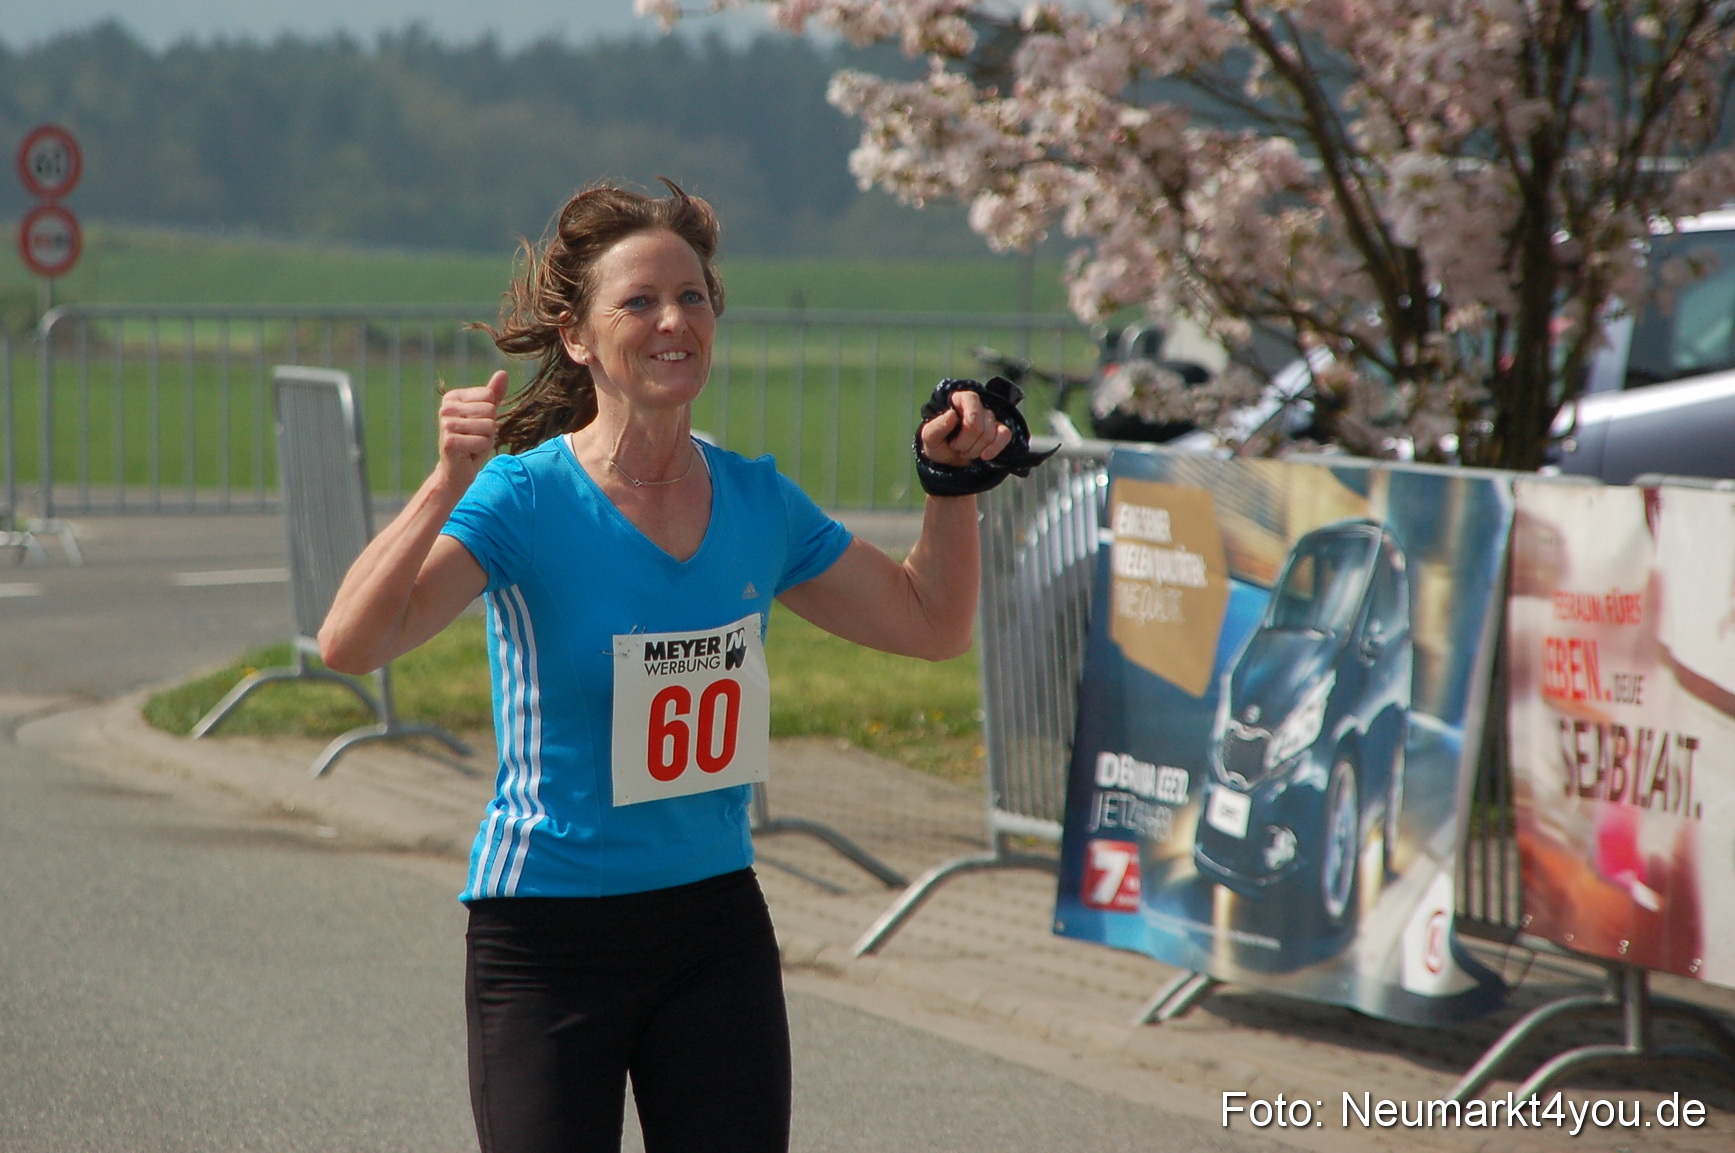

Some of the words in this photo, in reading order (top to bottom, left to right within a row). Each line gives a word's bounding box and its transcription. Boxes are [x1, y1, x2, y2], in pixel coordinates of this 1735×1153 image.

[644, 636, 721, 661] MEYER
[644, 656, 720, 676] WERBUNG
[647, 678, 742, 782] 60
